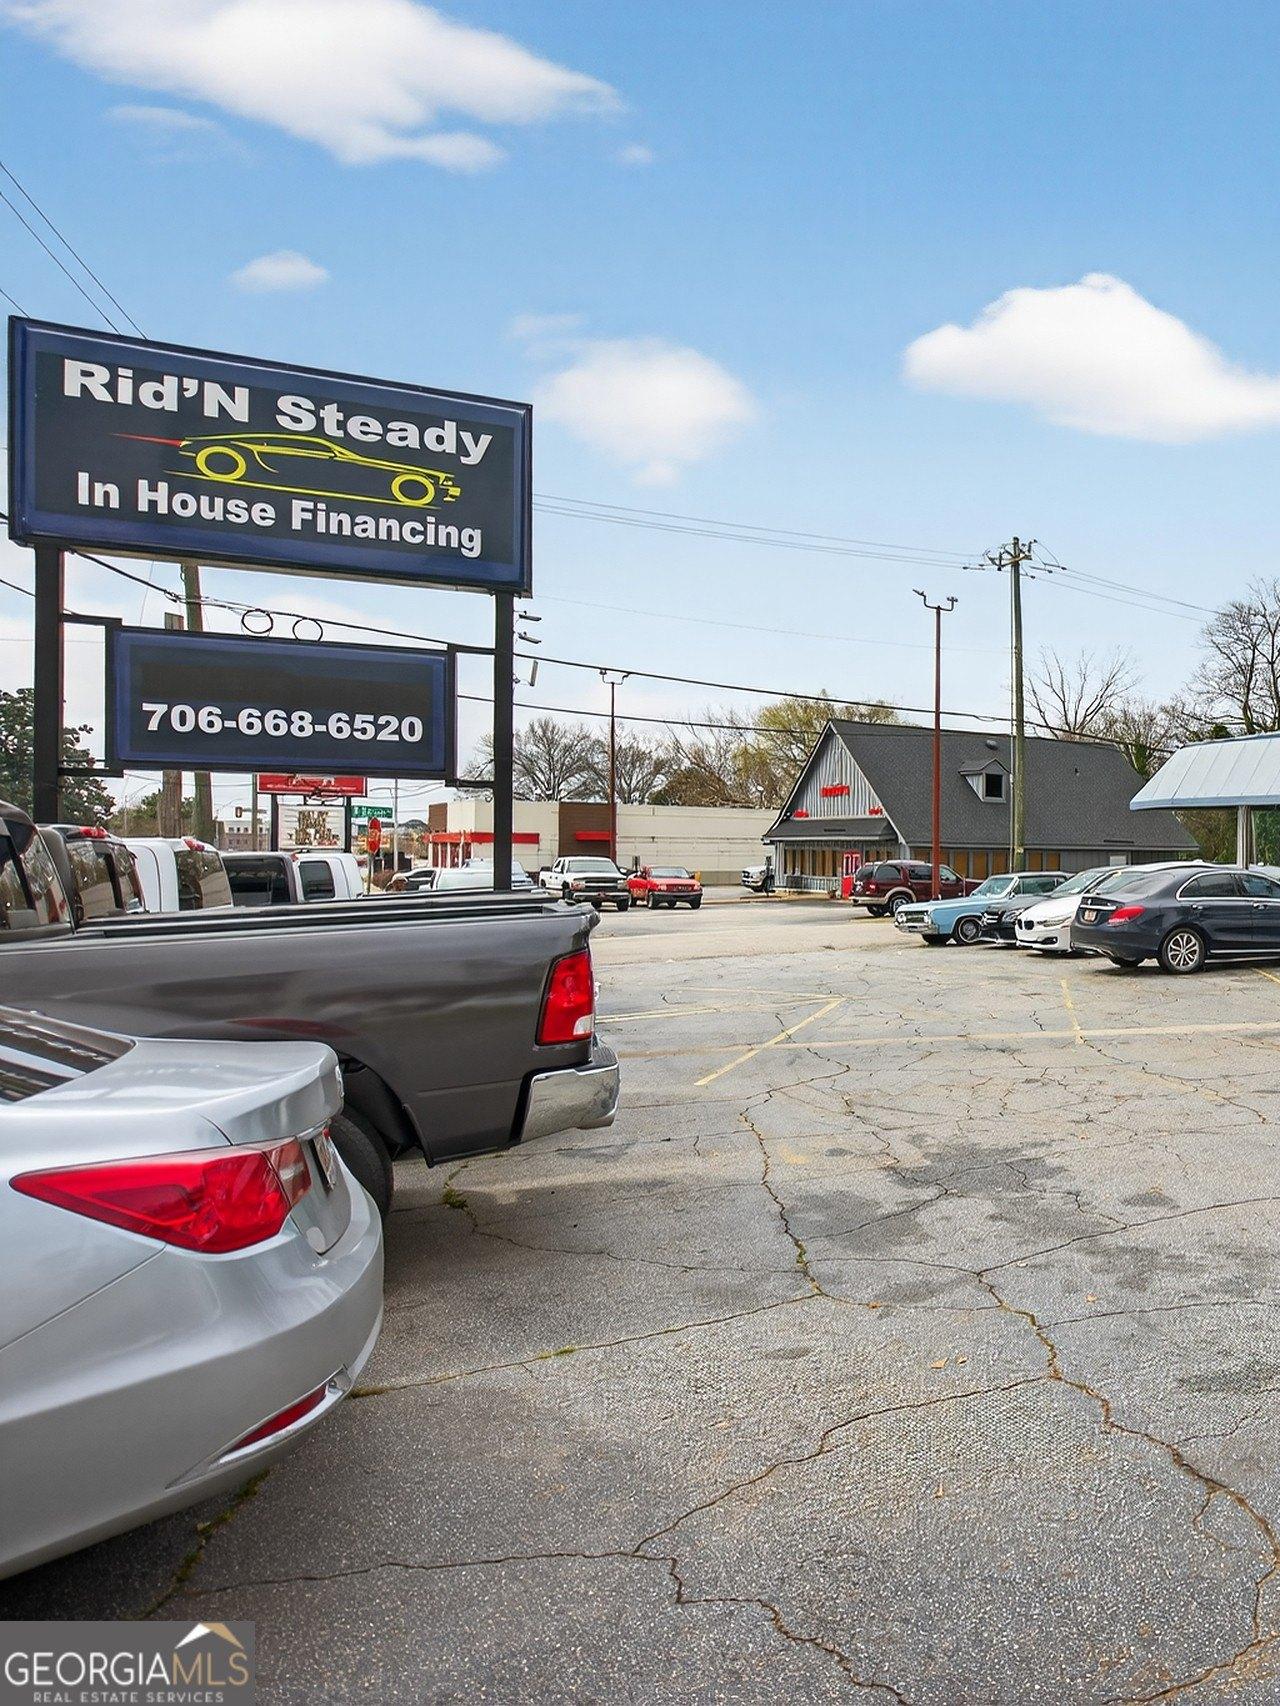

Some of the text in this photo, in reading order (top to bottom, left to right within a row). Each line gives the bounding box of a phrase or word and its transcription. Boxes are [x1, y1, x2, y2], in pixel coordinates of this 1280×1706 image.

[64, 358, 493, 466] Rid'N Steady
[77, 471, 482, 558] In House Financing
[142, 703, 424, 743] 706-668-6520
